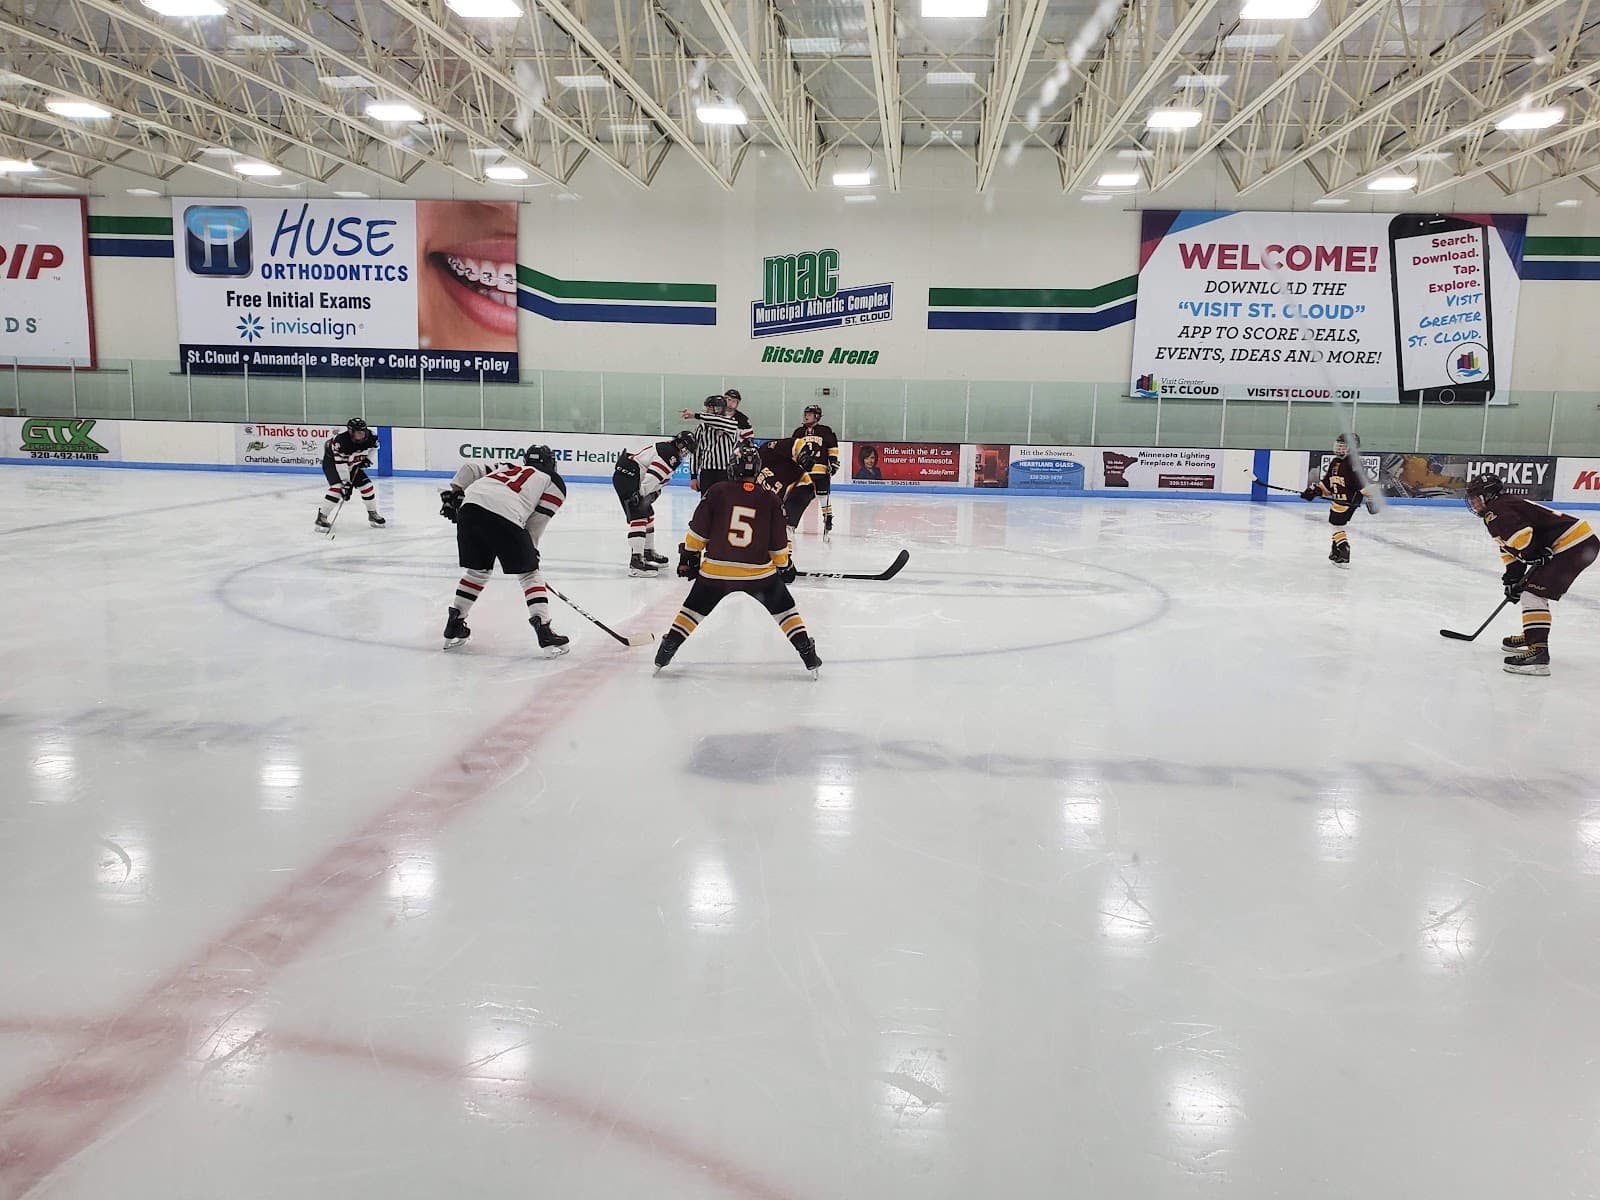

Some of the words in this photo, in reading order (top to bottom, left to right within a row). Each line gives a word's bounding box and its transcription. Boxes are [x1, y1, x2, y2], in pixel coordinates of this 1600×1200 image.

[270, 203, 397, 259] HUSE
[1431, 233, 1479, 249] Search.
[1178, 242, 1379, 273] WELCOME!
[1412, 247, 1479, 266] Download.
[261, 263, 409, 282] ORTHODONTICS
[1453, 264, 1480, 277] Tap.
[1312, 282, 1347, 296] THE
[1428, 278, 1481, 294] Explore.
[226, 290, 262, 308] Free
[267, 291, 314, 309] Initial
[319, 292, 371, 310] Exams
[755, 305, 804, 325] Municipal
[806, 299, 845, 318] Athletic
[847, 291, 889, 312] Complex
[1446, 292, 1483, 307] VISIT
[844, 317, 858, 325] ST.
[859, 311, 890, 323] CLOUD
[1247, 303, 1276, 318] ST.
[271, 317, 356, 340] invisalign
[1419, 311, 1482, 329] GREATER
[1177, 325, 1212, 339] APP
[1216, 326, 1239, 340] TO
[1242, 326, 1298, 341] SCORE
[1301, 328, 1361, 344] DEALS,
[1408, 335, 1427, 348] ST.
[1434, 329, 1482, 344] CLOUD.
[253, 351, 318, 366] Annandale
[330, 353, 375, 368] Becker
[388, 354, 417, 369] Cold
[419, 355, 461, 373] Spring
[474, 356, 510, 374] Foley
[761, 346, 824, 364] Ritsche
[828, 347, 880, 365] Arena
[1155, 347, 1226, 364] EVENTS,
[1229, 348, 1281, 363] IDEAS
[1283, 350, 1325, 363] AND
[1326, 351, 1382, 365] MORE!
[1160, 385, 1177, 395] ST.
[1178, 386, 1219, 396] CLOUD
[1177, 378, 1205, 386] Greater
[21, 418, 105, 447] GTX
[256, 425, 295, 438] Thanks
[297, 427, 309, 438] to
[311, 429, 329, 438] our
[459, 443, 572, 462] CENTRARE
[883, 447, 899, 455] Ride
[901, 447, 915, 456] with
[917, 448, 928, 456] the
[1180, 452, 1210, 460] Lighting
[244, 456, 281, 464] Charitable
[281, 457, 315, 466] Gambling
[883, 457, 907, 465] insurer
[1140, 459, 1174, 467] Fireplace
[1184, 461, 1216, 469] Flooring
[1466, 461, 1549, 485] HOCKEY
[727, 505, 757, 549] 5
